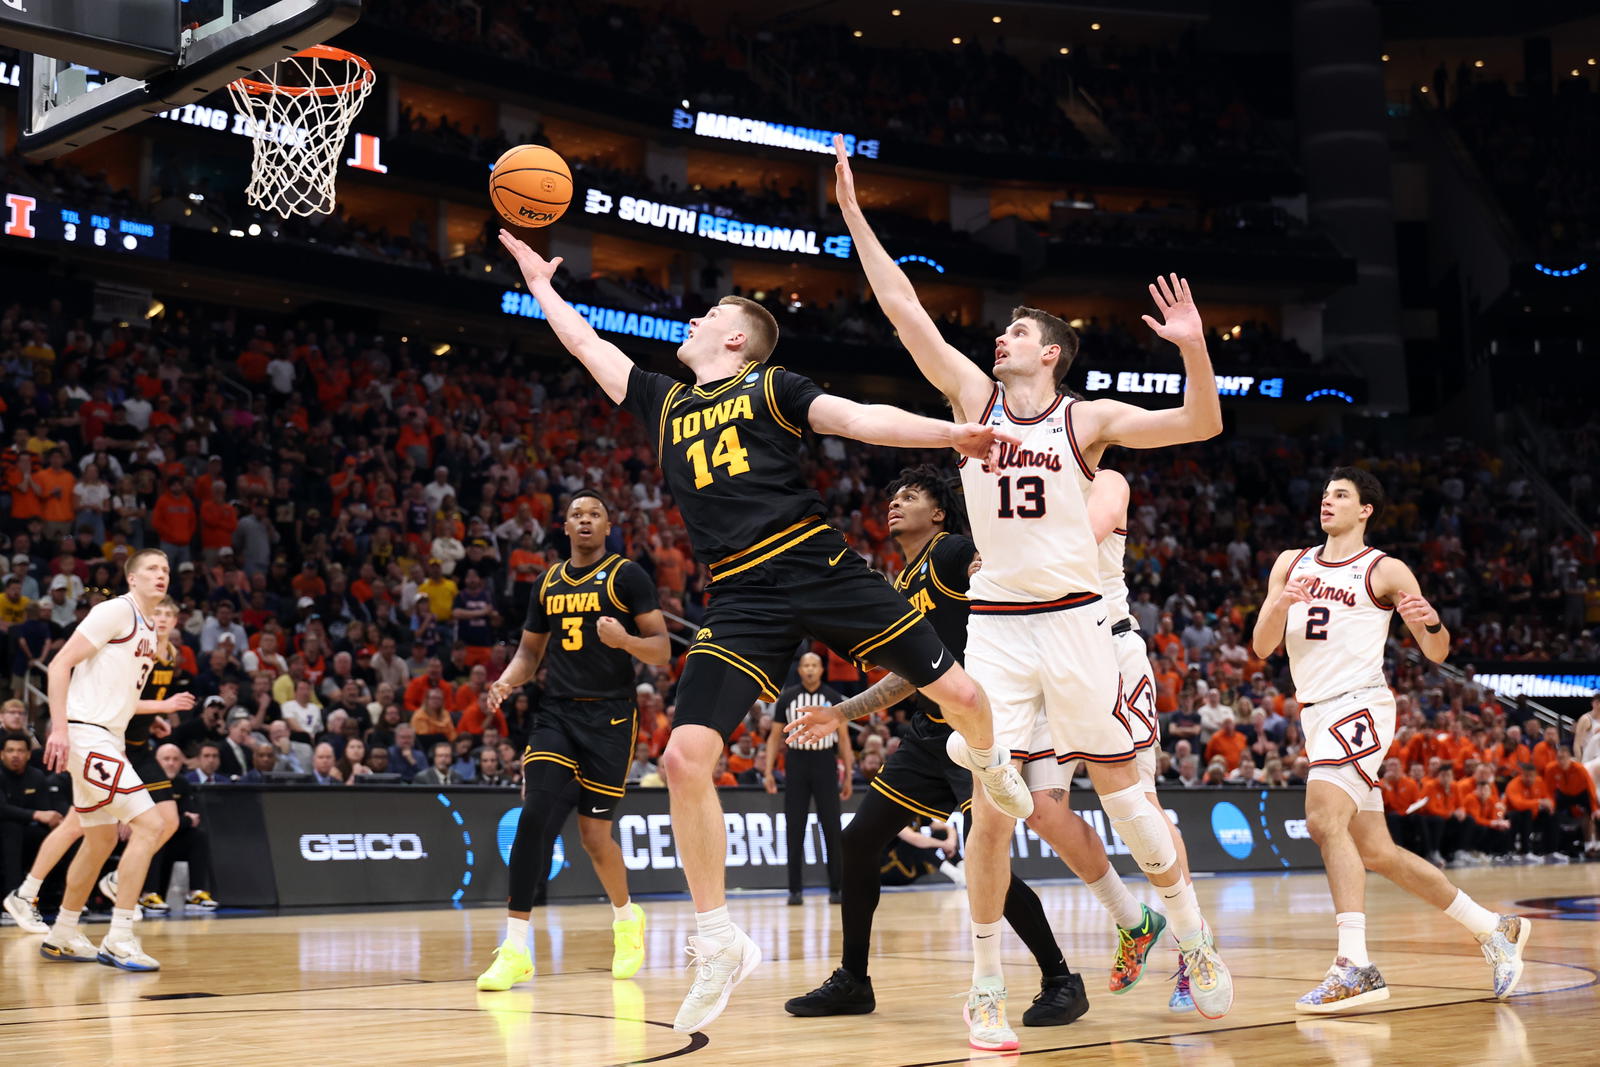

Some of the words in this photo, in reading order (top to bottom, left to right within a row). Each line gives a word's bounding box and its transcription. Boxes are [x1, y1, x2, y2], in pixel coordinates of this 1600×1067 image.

[119, 219, 154, 237] BONUS
[518, 206, 557, 221] NCAA
[618, 194, 697, 234] SOUTH
[698, 213, 820, 254] REGIONAL
[64, 223, 77, 241] 3
[1117, 371, 1181, 394] ELITE
[672, 394, 754, 446] IOWA
[686, 425, 751, 490] 14
[981, 441, 1062, 474] llinois
[998, 475, 1046, 519] 13
[546, 591, 601, 616] IOWA
[908, 587, 937, 615] WA
[561, 616, 584, 651] 3
[1305, 606, 1331, 641] 2
[299, 833, 423, 861] GEICO
